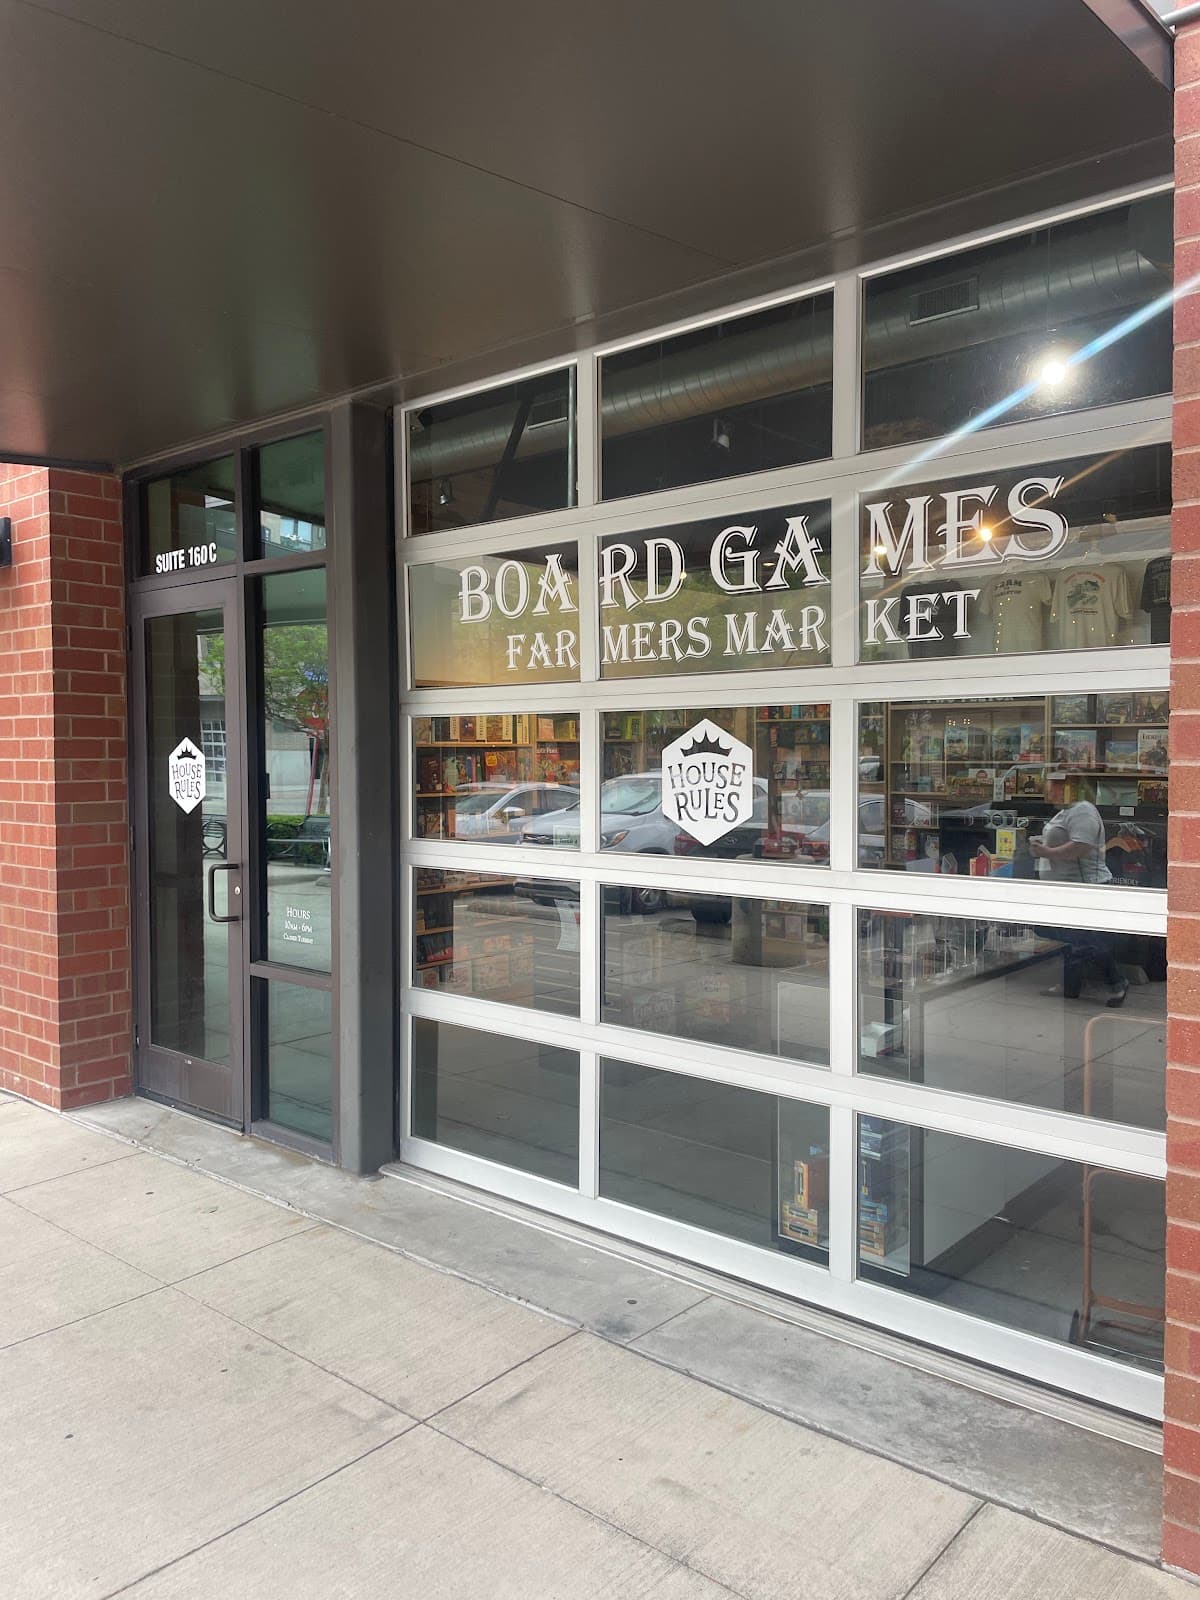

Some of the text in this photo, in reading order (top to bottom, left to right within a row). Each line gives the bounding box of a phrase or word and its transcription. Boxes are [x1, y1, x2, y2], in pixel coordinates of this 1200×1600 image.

[155, 549, 186, 573] SUITE
[458, 475, 1069, 623] BOARD GAMES
[506, 589, 981, 671] FARMERS MARKET
[171, 763, 203, 780] HOUSE
[667, 762, 746, 789] HOUSE
[174, 778, 201, 800] RULES
[674, 788, 740, 823] RULES
